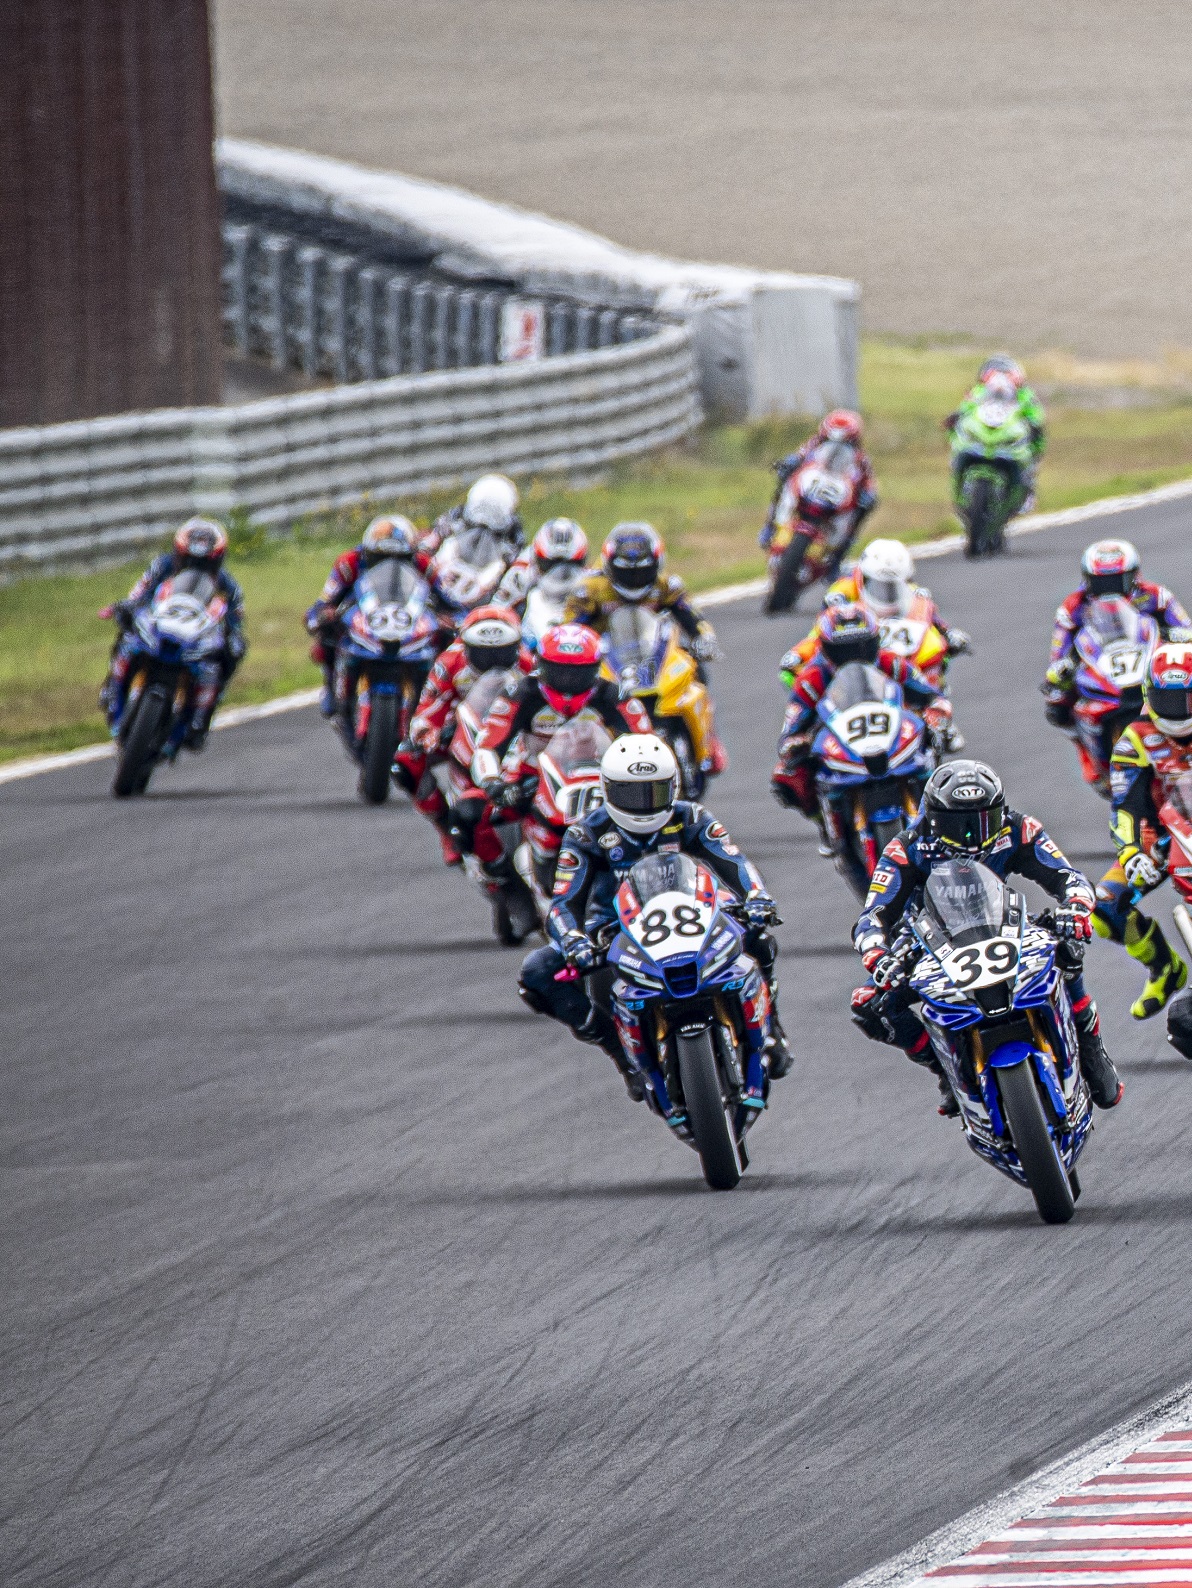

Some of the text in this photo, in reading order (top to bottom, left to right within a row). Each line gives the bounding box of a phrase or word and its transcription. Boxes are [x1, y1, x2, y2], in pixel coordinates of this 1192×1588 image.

[1110, 650, 1142, 678] 57
[848, 713, 890, 743] 99
[633, 763, 655, 772] Arai
[956, 788, 981, 797] KYT
[916, 843, 937, 851] KYT
[640, 904, 706, 948] 88
[952, 940, 1018, 989] 39
